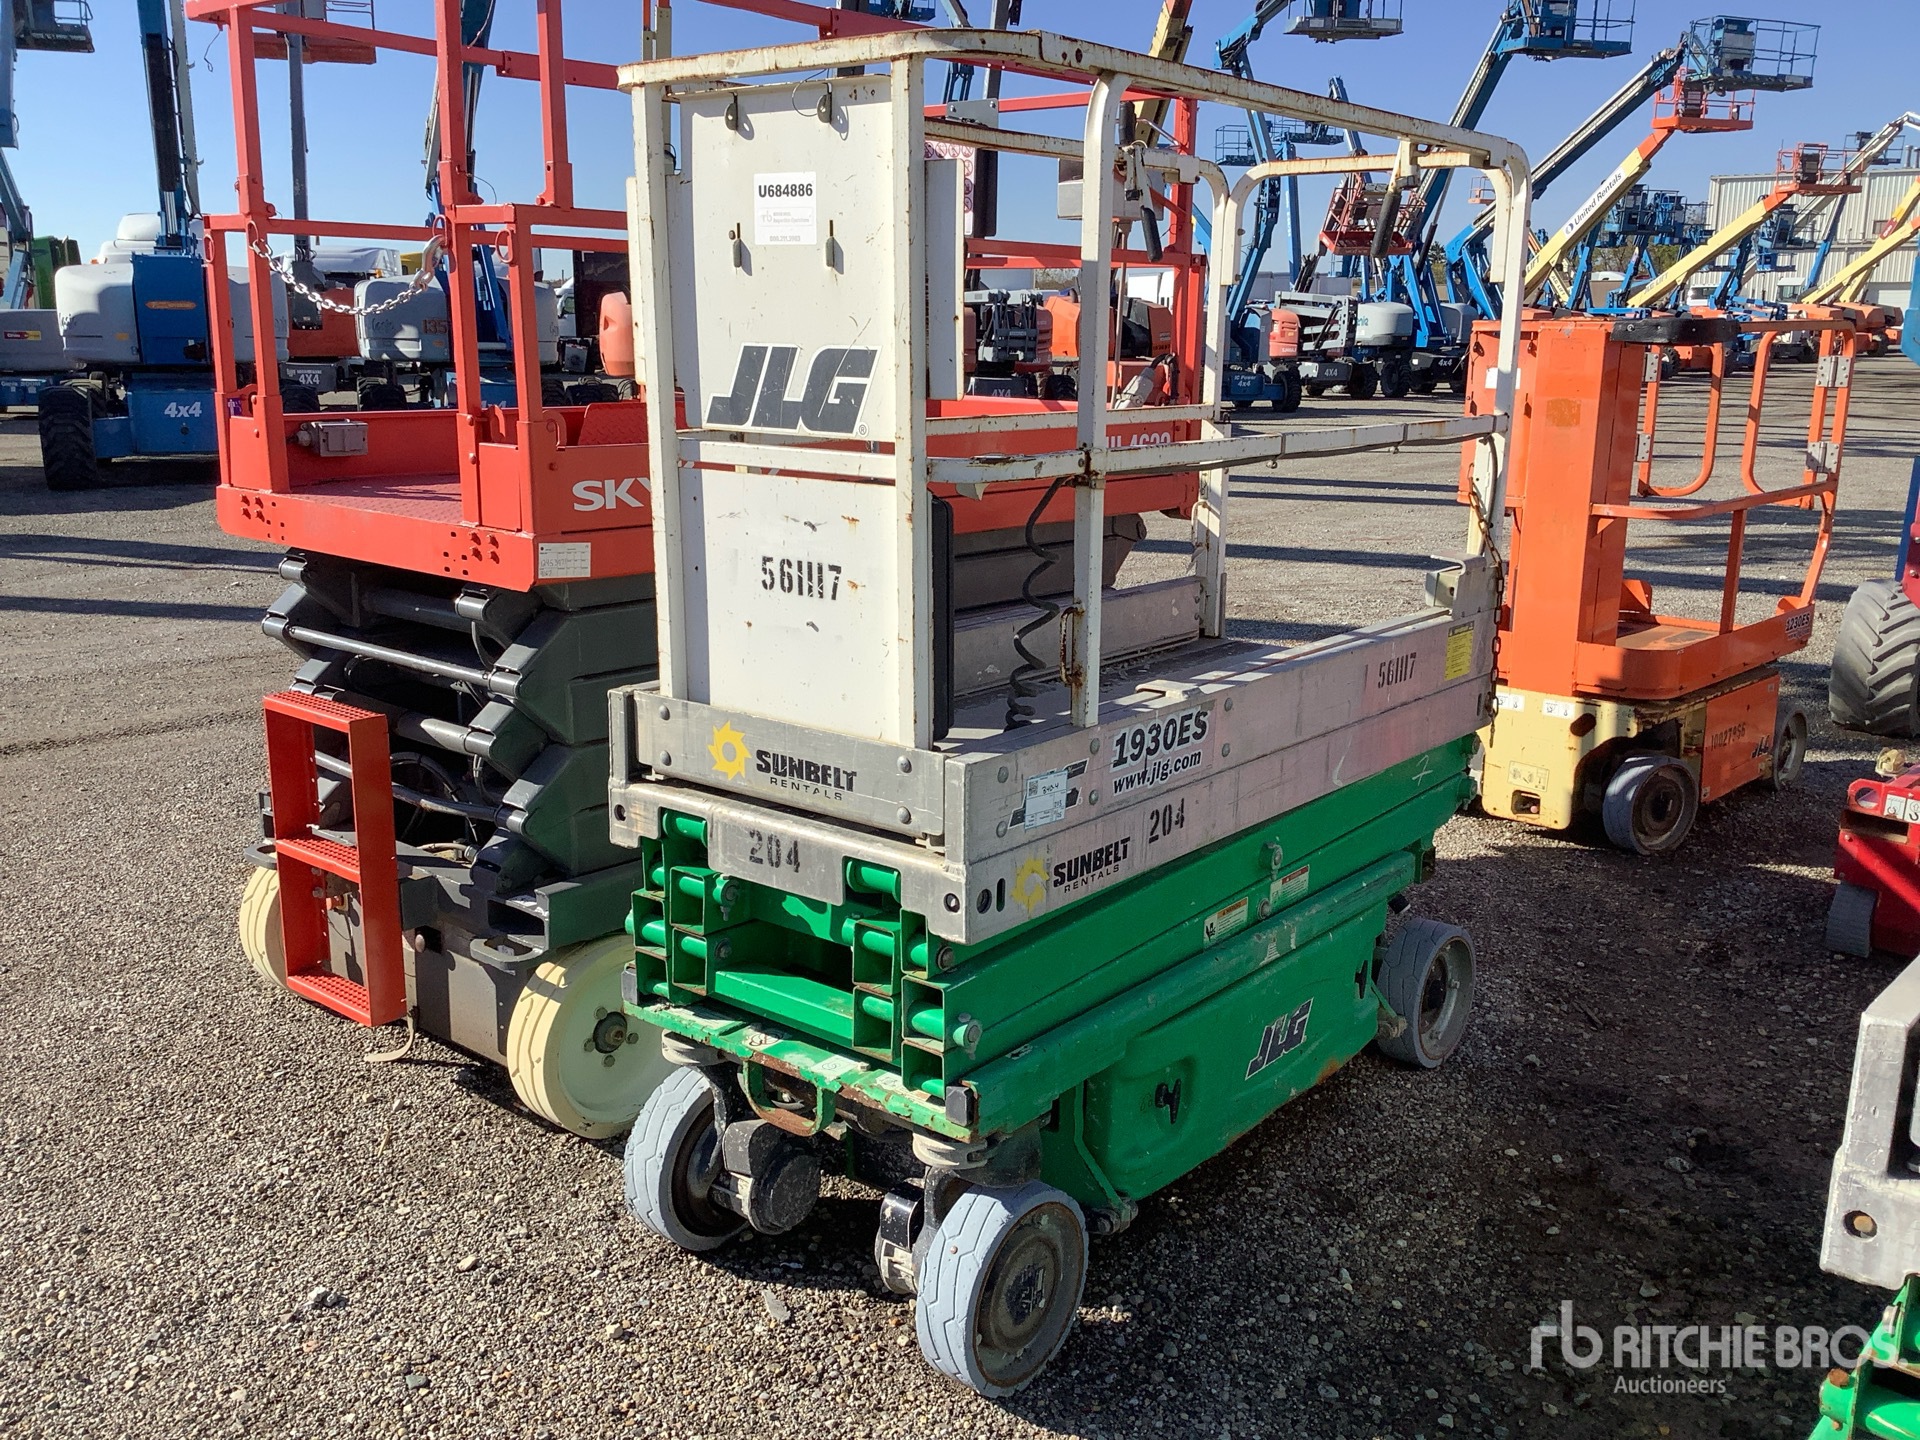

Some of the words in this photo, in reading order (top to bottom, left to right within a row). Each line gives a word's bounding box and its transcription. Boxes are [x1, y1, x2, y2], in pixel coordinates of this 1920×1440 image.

[758, 183, 813, 198] U684886
[1574, 198, 1597, 226] United
[1597, 172, 1622, 201] Rentals
[1526, 256, 1541, 272] LIFT
[299, 374, 320, 385] 4X4
[705, 344, 879, 435] JLG
[1324, 368, 1338, 377] 4X4
[164, 401, 202, 418] 4x4
[1786, 613, 1811, 632] 1230ES
[1112, 709, 1209, 768] 1930ES
[756, 749, 857, 793] SUNBELT
[770, 776, 842, 800] RENTALS
[1113, 750, 1201, 794] www.jlg.com
[1148, 797, 1185, 844] 204
[749, 829, 800, 873] 204
[1053, 837, 1131, 888] SUNBELT
[1064, 864, 1119, 893] RENTALS
[1245, 997, 1314, 1080] JLG
